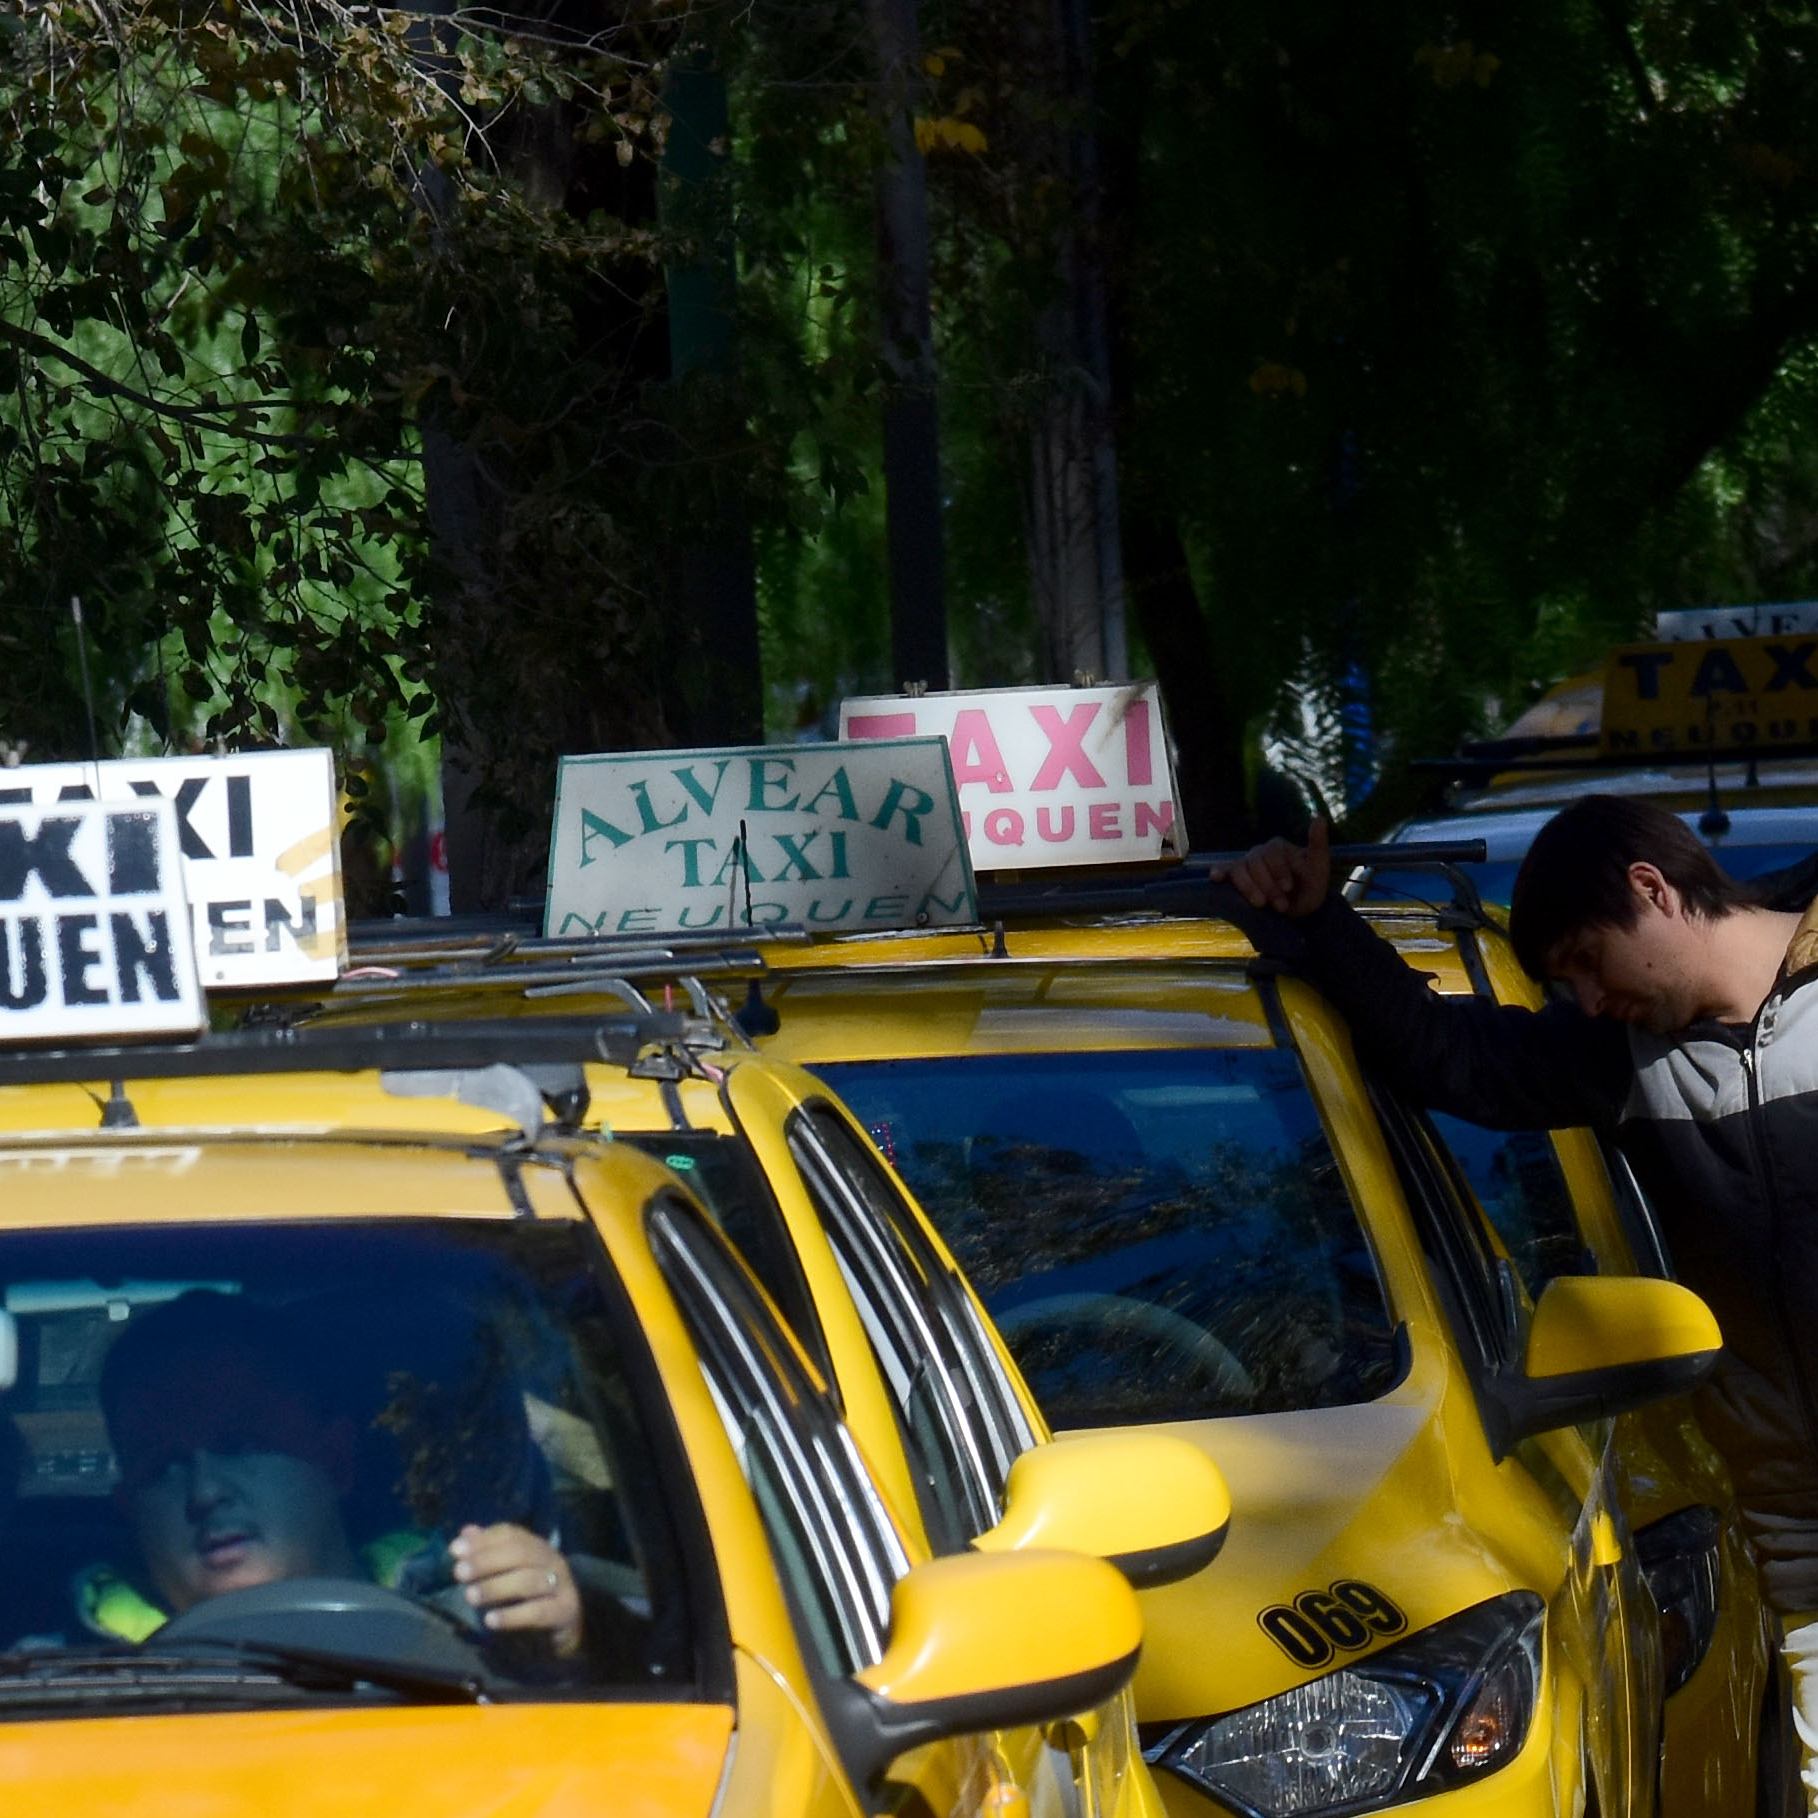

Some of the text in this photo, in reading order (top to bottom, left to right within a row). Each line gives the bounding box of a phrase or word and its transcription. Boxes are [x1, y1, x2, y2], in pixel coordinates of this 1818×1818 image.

[579, 758, 935, 868] ALVEAR
[962, 801, 1174, 847] QUEN
[664, 830, 851, 888] TAXI
[558, 890, 966, 936] NEUQUEN
[1257, 1578, 1409, 1670] 069
